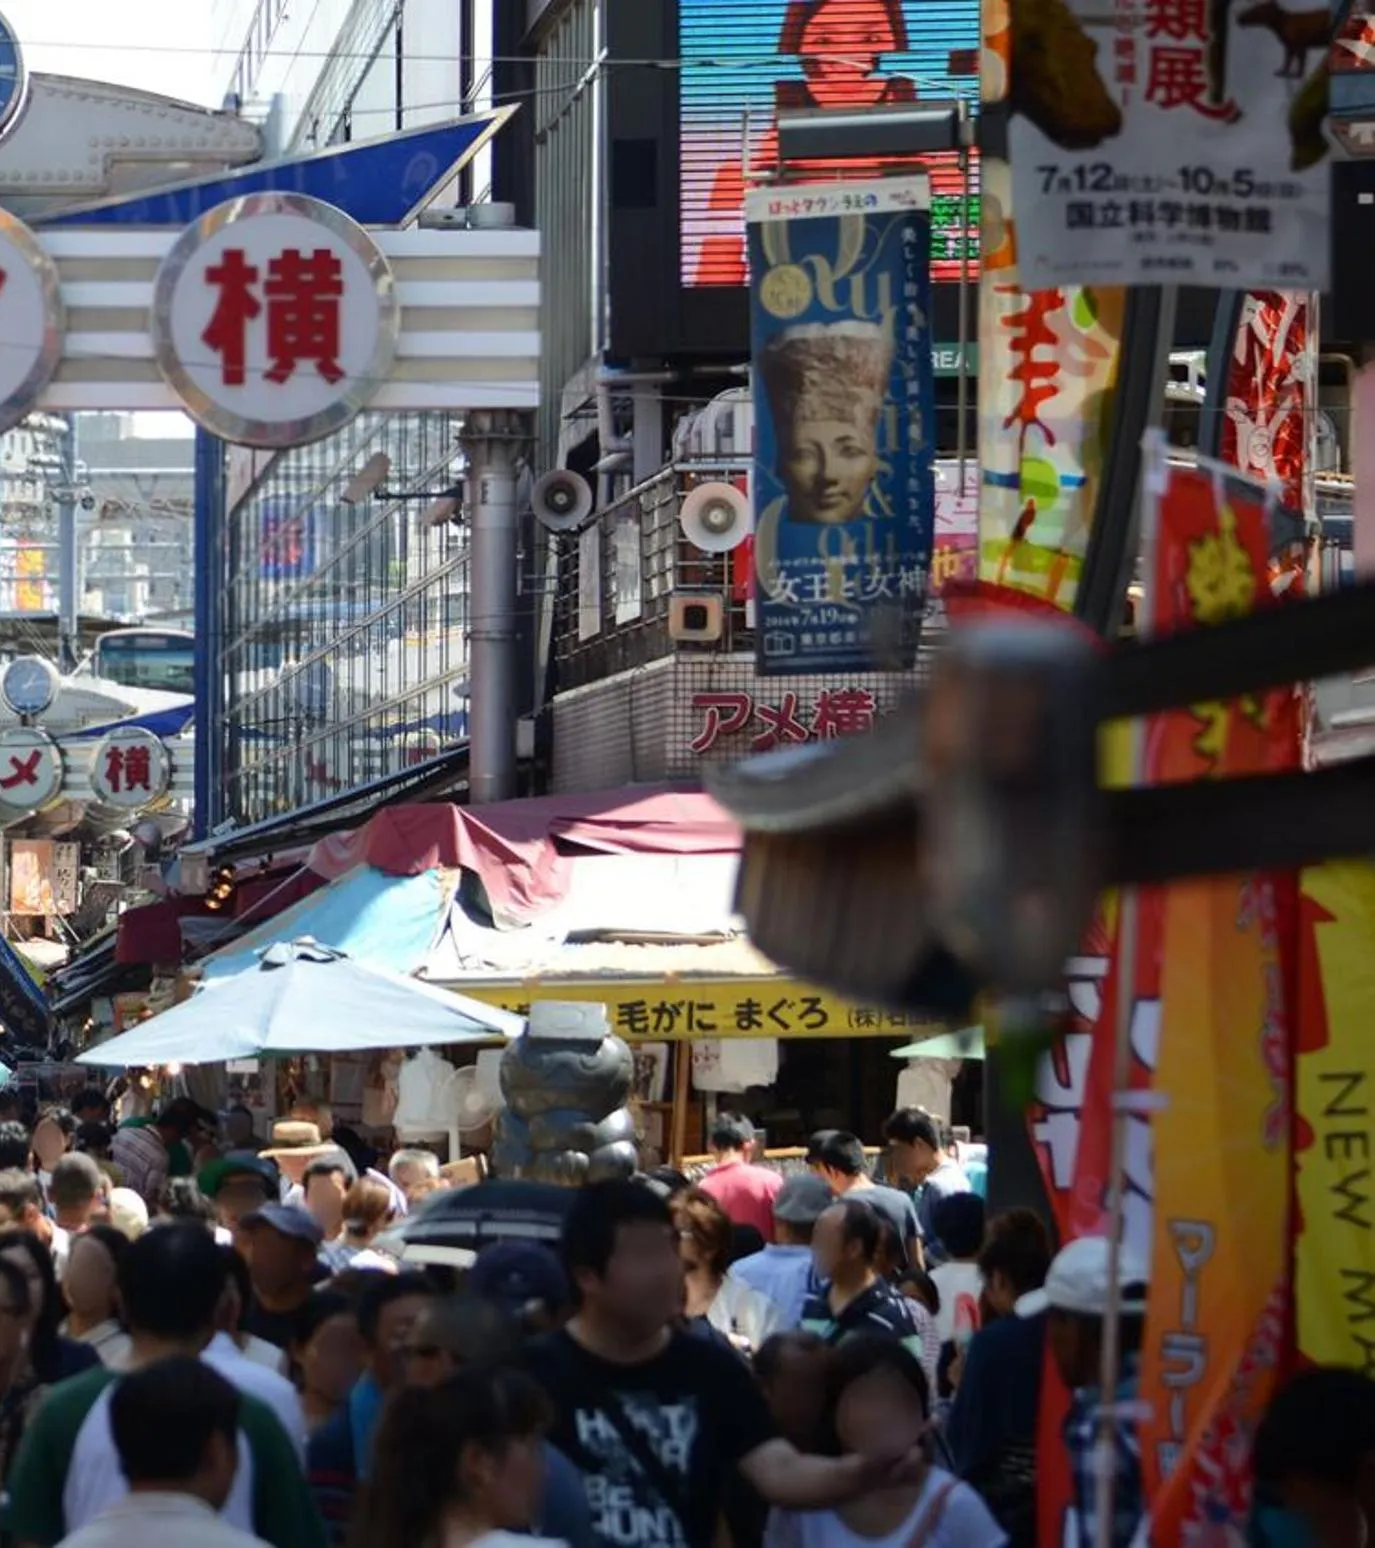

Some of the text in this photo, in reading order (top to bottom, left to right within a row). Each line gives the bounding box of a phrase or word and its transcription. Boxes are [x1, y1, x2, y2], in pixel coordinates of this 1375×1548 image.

[1066, 200, 1272, 233] 国立科学博物館
[763, 564, 928, 605] 女王と女神
[691, 688, 876, 752] アメ横
[617, 1000, 717, 1033] 毛がに
[734, 997, 829, 1031] まぐろ
[1317, 1071, 1373, 1230] NEW
